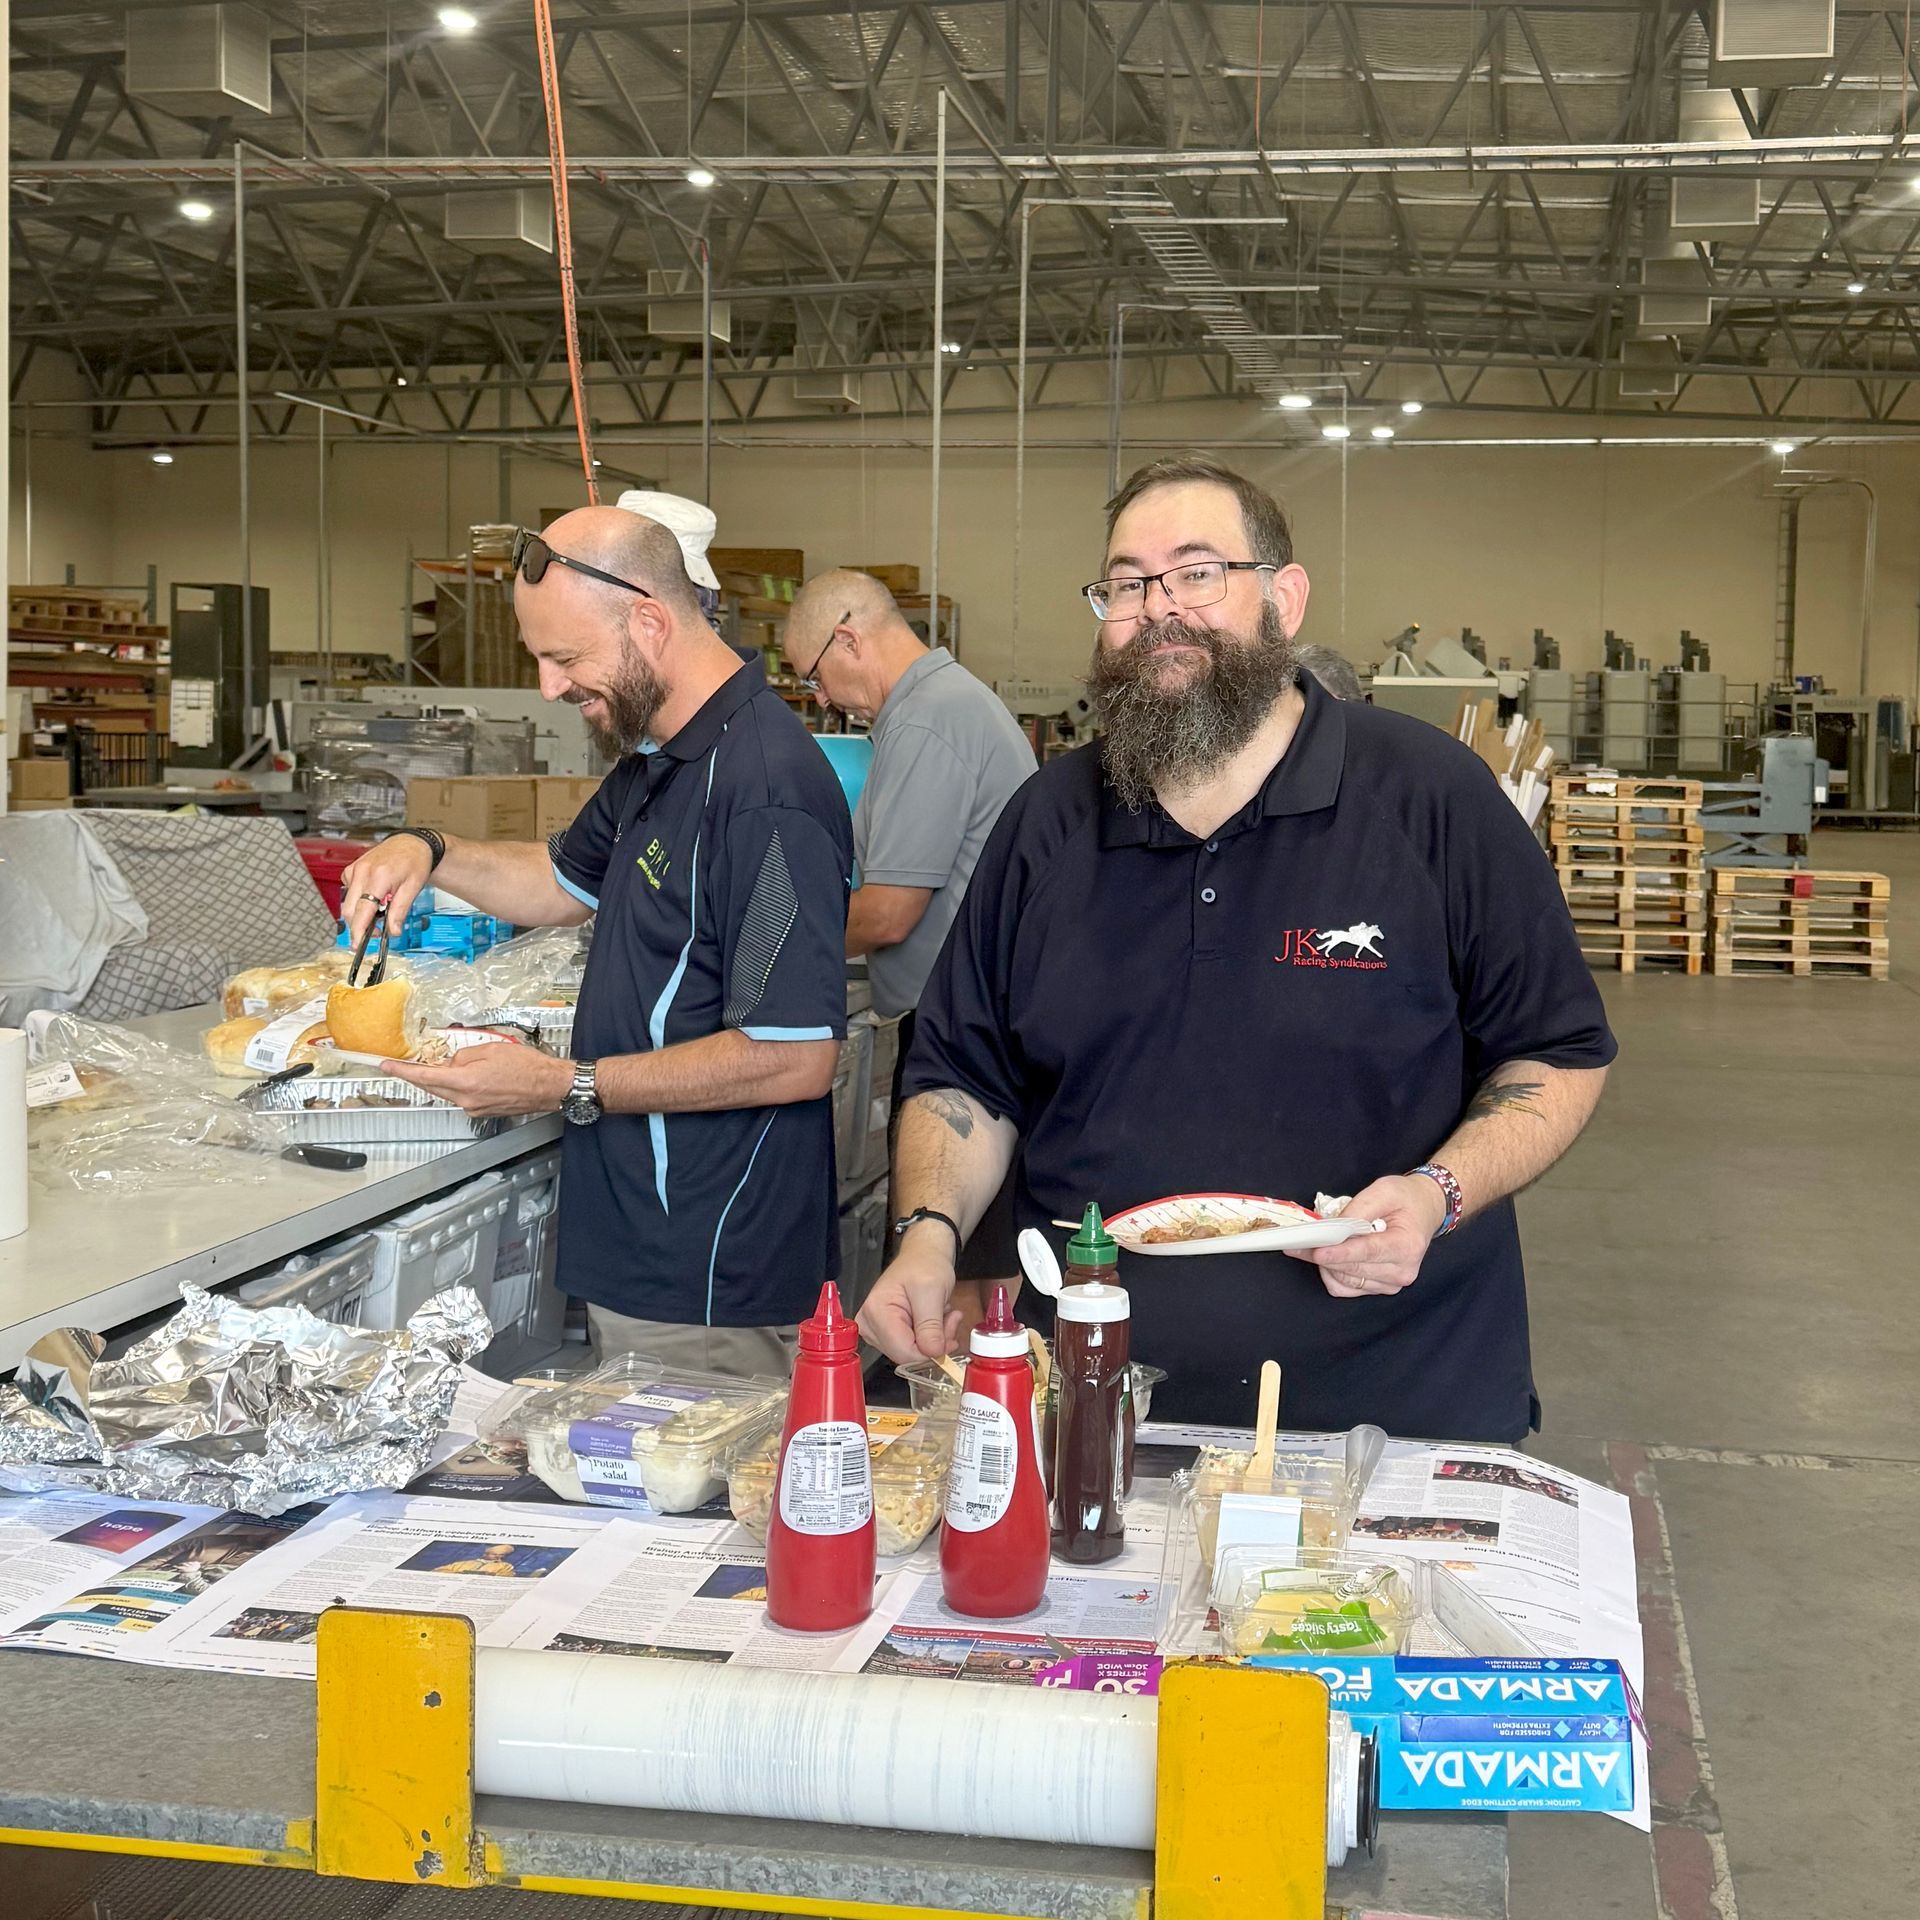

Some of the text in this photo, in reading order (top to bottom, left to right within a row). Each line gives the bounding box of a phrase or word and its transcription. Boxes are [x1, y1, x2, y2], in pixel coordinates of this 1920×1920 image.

[1274, 928, 1321, 962] JK
[1293, 957, 1388, 969] Racing Syndications
[977, 1409, 1000, 1419] SAUCE
[593, 1459, 624, 1470] Potato
[602, 1470, 628, 1481] salad
[99, 1521, 144, 1533] hope
[1290, 1621, 1362, 1635] Tasty Slices
[1394, 1677, 1611, 1702] ARMADA
[1399, 1751, 1620, 1788] ARMADA
[1460, 1798, 1581, 1806] CAUTION: SHARP CUTTING EDGE
